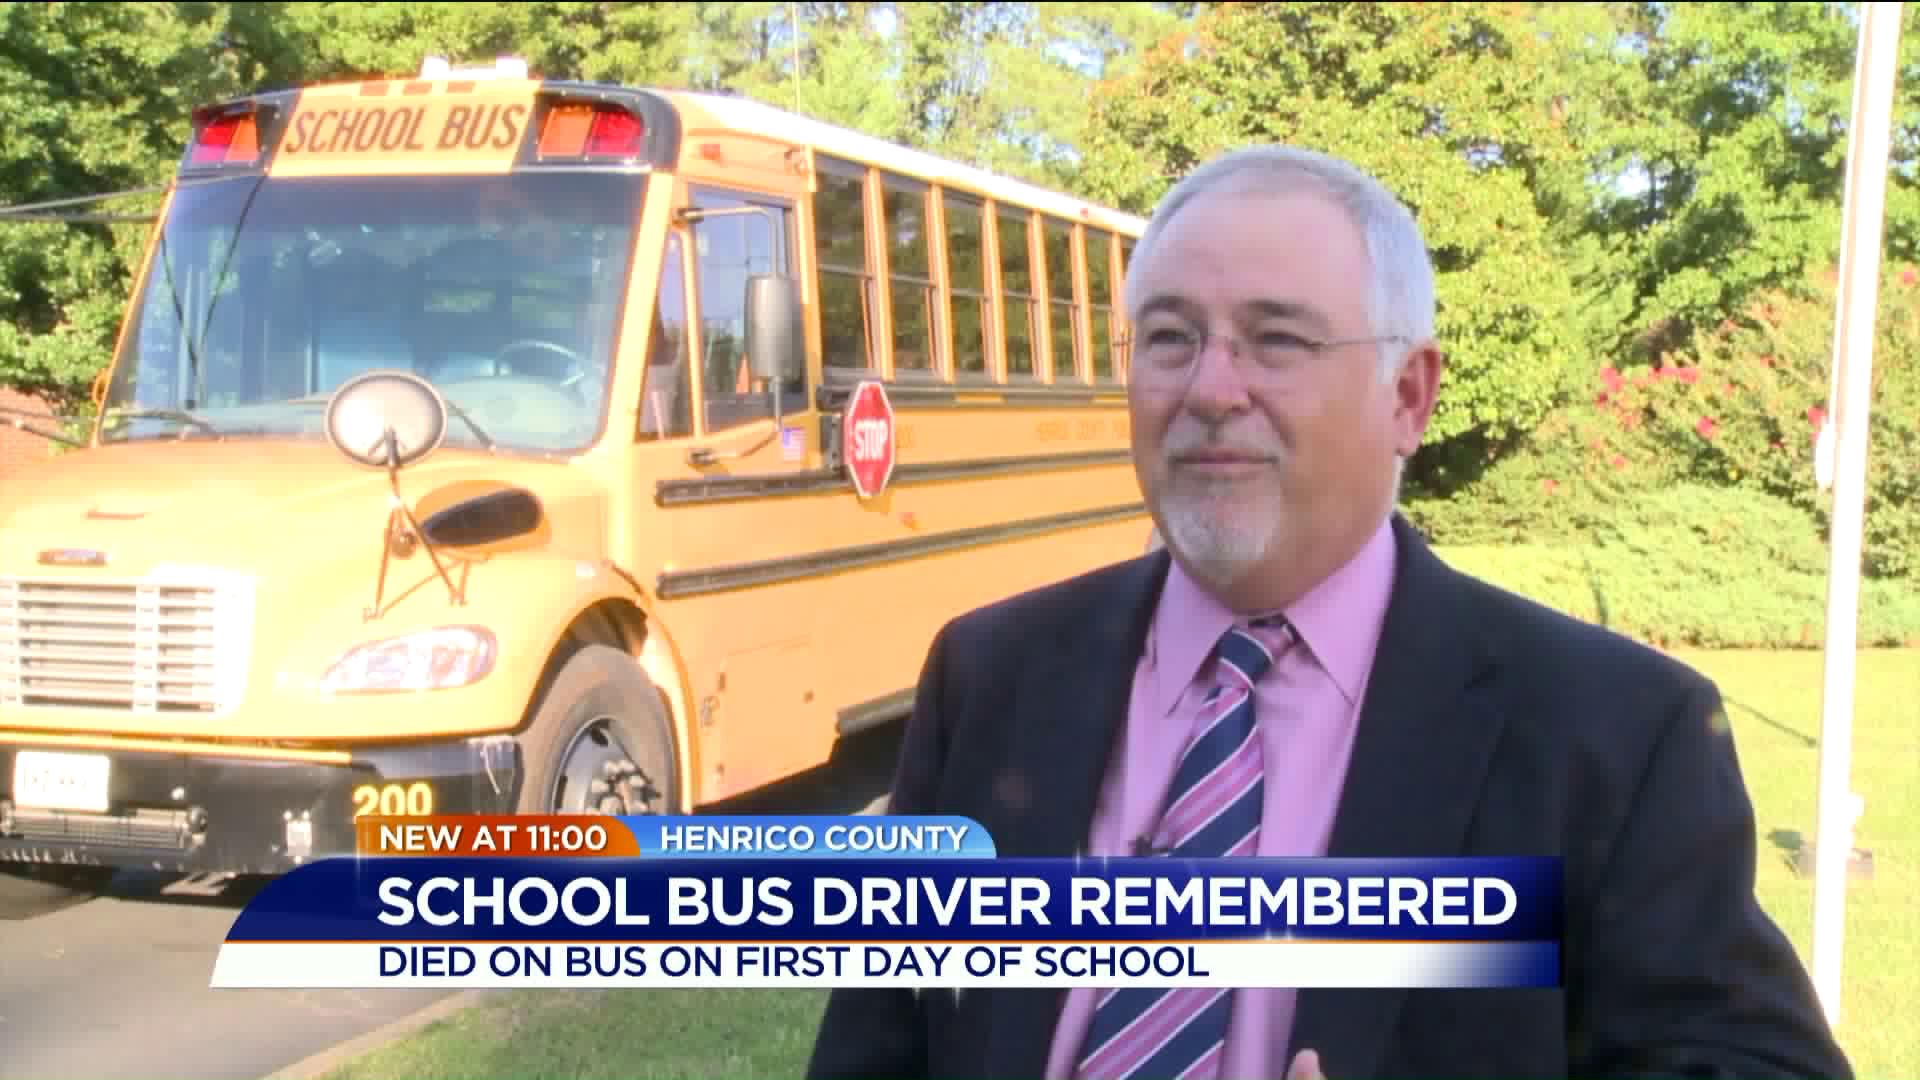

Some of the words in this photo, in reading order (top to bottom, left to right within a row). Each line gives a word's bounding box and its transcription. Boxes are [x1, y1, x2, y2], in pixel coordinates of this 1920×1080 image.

[285, 105, 427, 153] SCHOOL
[435, 103, 526, 150] BUS
[854, 418, 889, 460] STOP
[354, 783, 433, 817] 200
